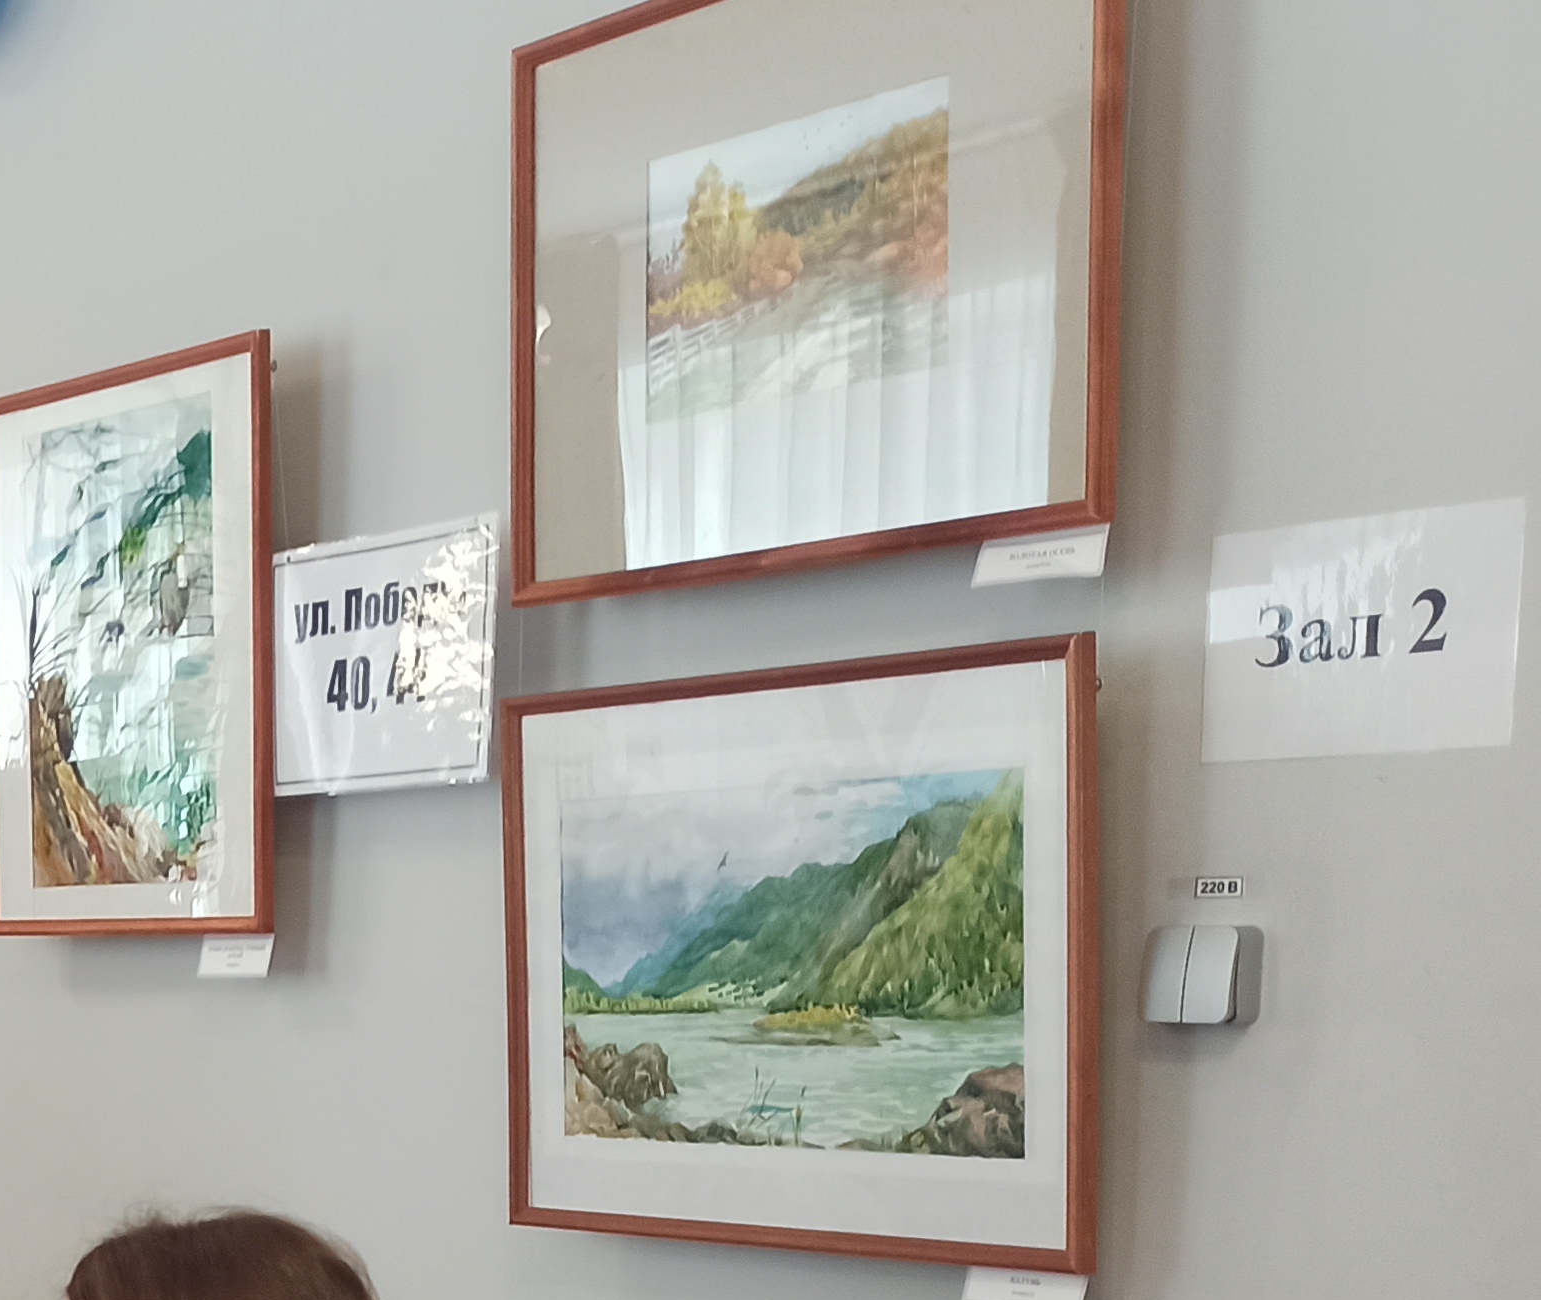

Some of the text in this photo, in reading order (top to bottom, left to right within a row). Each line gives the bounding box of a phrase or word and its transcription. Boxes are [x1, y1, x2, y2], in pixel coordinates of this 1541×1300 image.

[294, 580, 467, 644] ул. Побед
[1254, 588, 1448, 667] Зал 2
[326, 655, 378, 715] 40,
[1199, 880, 1238, 895] 220 В
